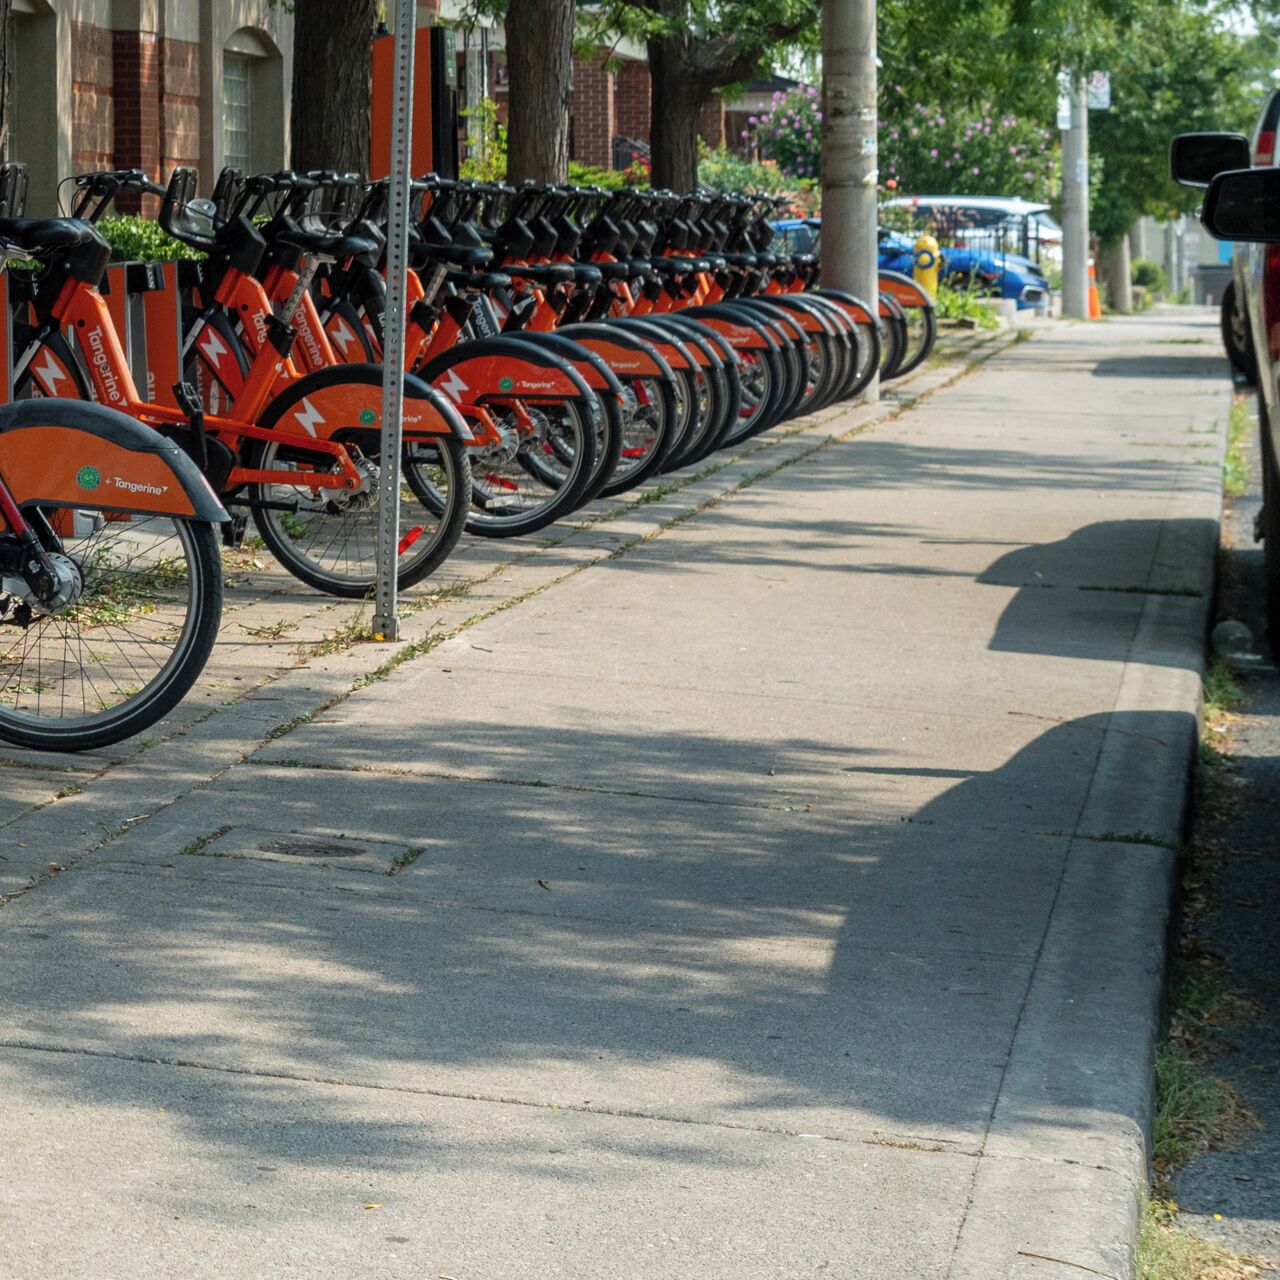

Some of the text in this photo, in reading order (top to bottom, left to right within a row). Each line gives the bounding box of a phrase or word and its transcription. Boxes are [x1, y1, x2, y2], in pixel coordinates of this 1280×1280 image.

[295, 304, 323, 366] Tangerine
[472, 297, 495, 338] Tanger
[88, 325, 120, 401] Tangerine
[114, 476, 162, 495] Tangerine
